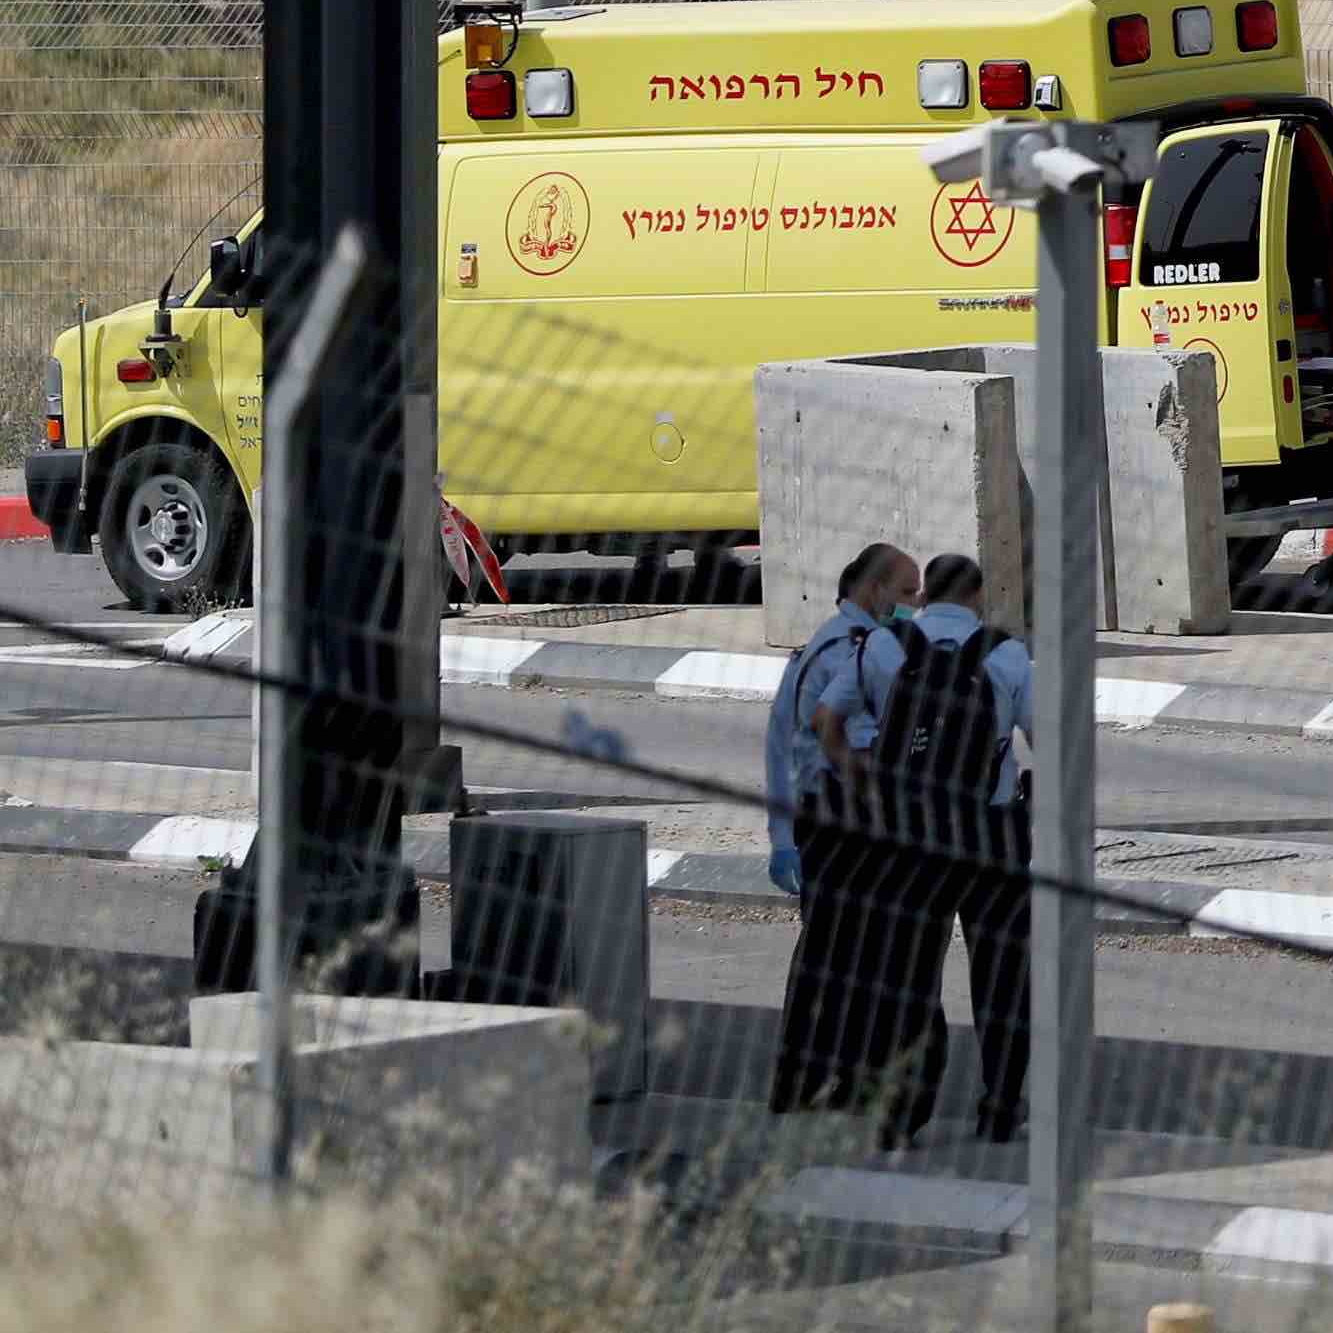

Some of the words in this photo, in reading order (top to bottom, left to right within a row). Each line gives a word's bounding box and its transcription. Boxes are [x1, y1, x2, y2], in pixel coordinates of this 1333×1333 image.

[650, 73, 801, 101] הרפואה
[814, 66, 885, 99] חיל
[622, 208, 686, 240] נמרץ
[695, 202, 770, 232] טיפול
[780, 201, 897, 230] אמבולנס
[1153, 262, 1221, 284] REDLER
[1140, 305, 1190, 330] נמץ
[1196, 300, 1258, 323] טיפול
